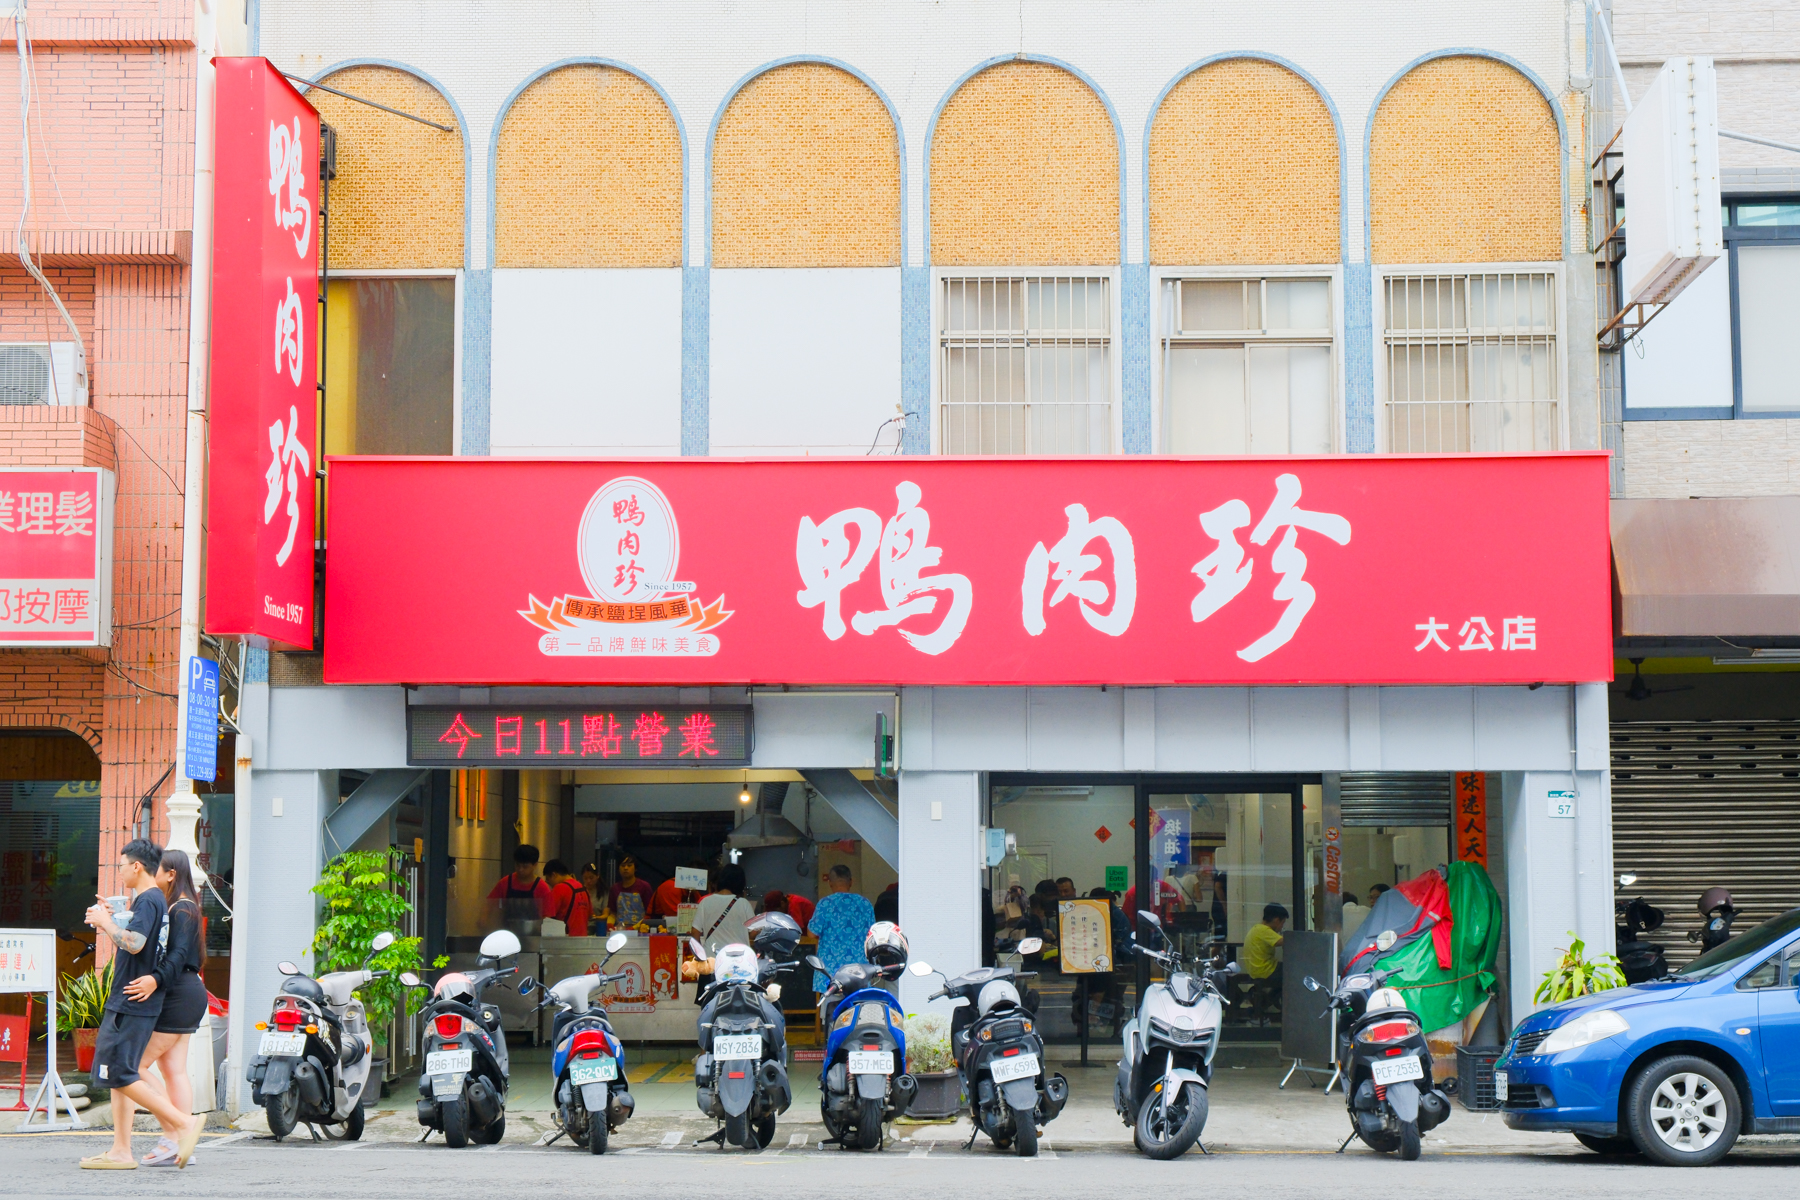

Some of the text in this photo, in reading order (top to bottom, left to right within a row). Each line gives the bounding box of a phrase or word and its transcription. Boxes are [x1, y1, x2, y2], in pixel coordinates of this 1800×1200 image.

[264, 116, 311, 567] 鴨肉珍
[612, 494, 645, 596] 鴨肉珍
[644, 582, 692, 591] Since 1957
[797, 474, 1352, 662] 鴨肉珍
[264, 595, 303, 625] Since 1957
[566, 599, 688, 621] 傳承鹽埕風華
[544, 636, 712, 653] 第一品牌鮮味美食
[1414, 615, 1537, 652] 大公店
[438, 713, 719, 759] 今日11點營業
[1461, 772, 1483, 864] 味迷人天
[1557, 804, 1571, 815] 57
[1326, 845, 1341, 895] Castrol
